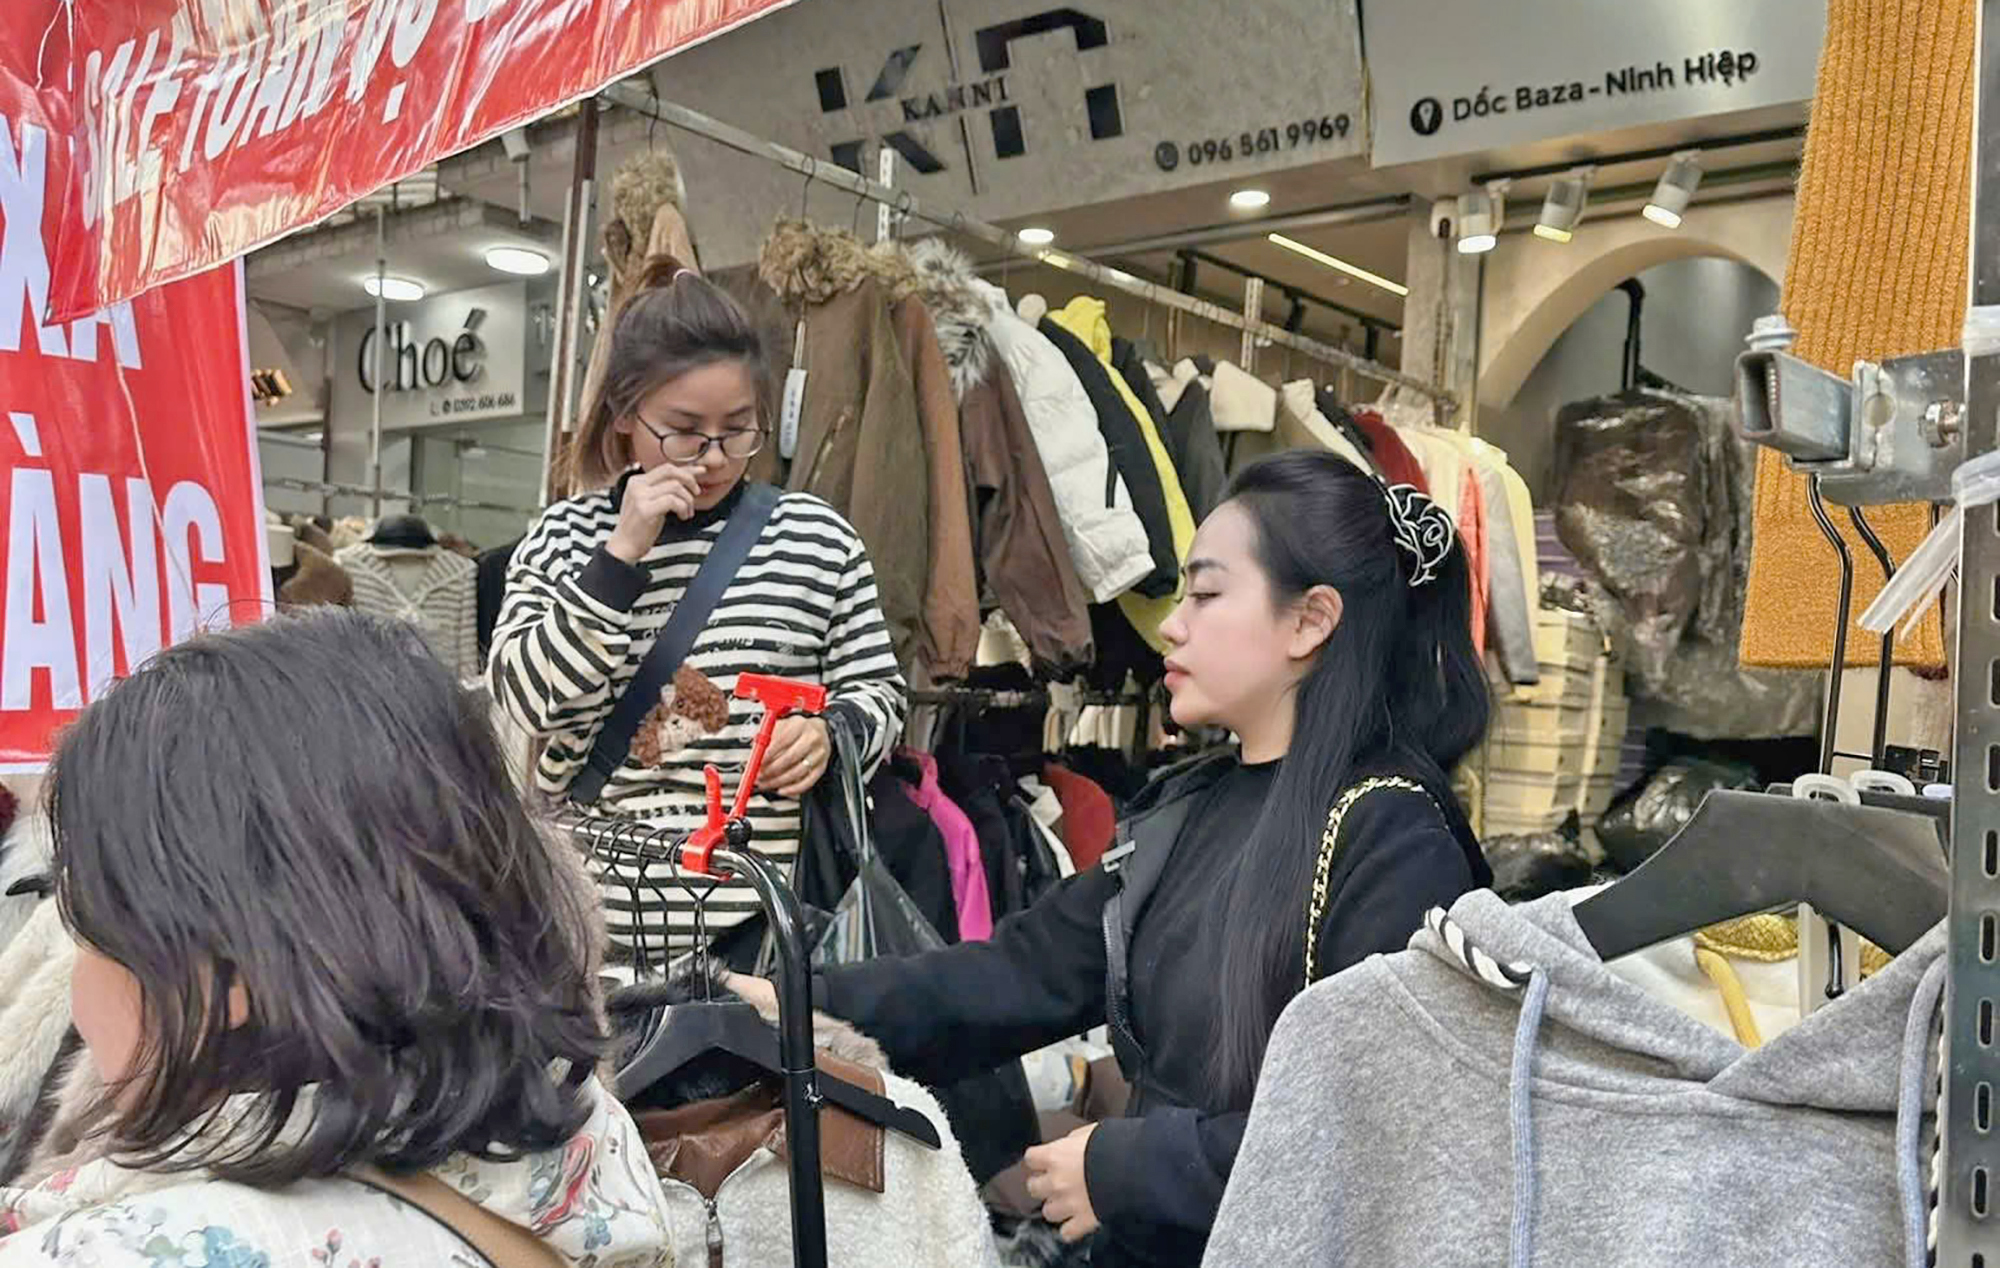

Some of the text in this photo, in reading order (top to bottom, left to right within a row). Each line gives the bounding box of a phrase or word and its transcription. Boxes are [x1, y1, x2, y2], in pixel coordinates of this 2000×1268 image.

[1453, 86, 1508, 121] Dốc
[1516, 83, 1584, 109] Baza
[1605, 63, 1674, 96] Ninh
[1684, 50, 1757, 87] Hiệp
[1285, 113, 1350, 149] 9969
[0, 113, 143, 370] X
[358, 307, 487, 395] Choé
